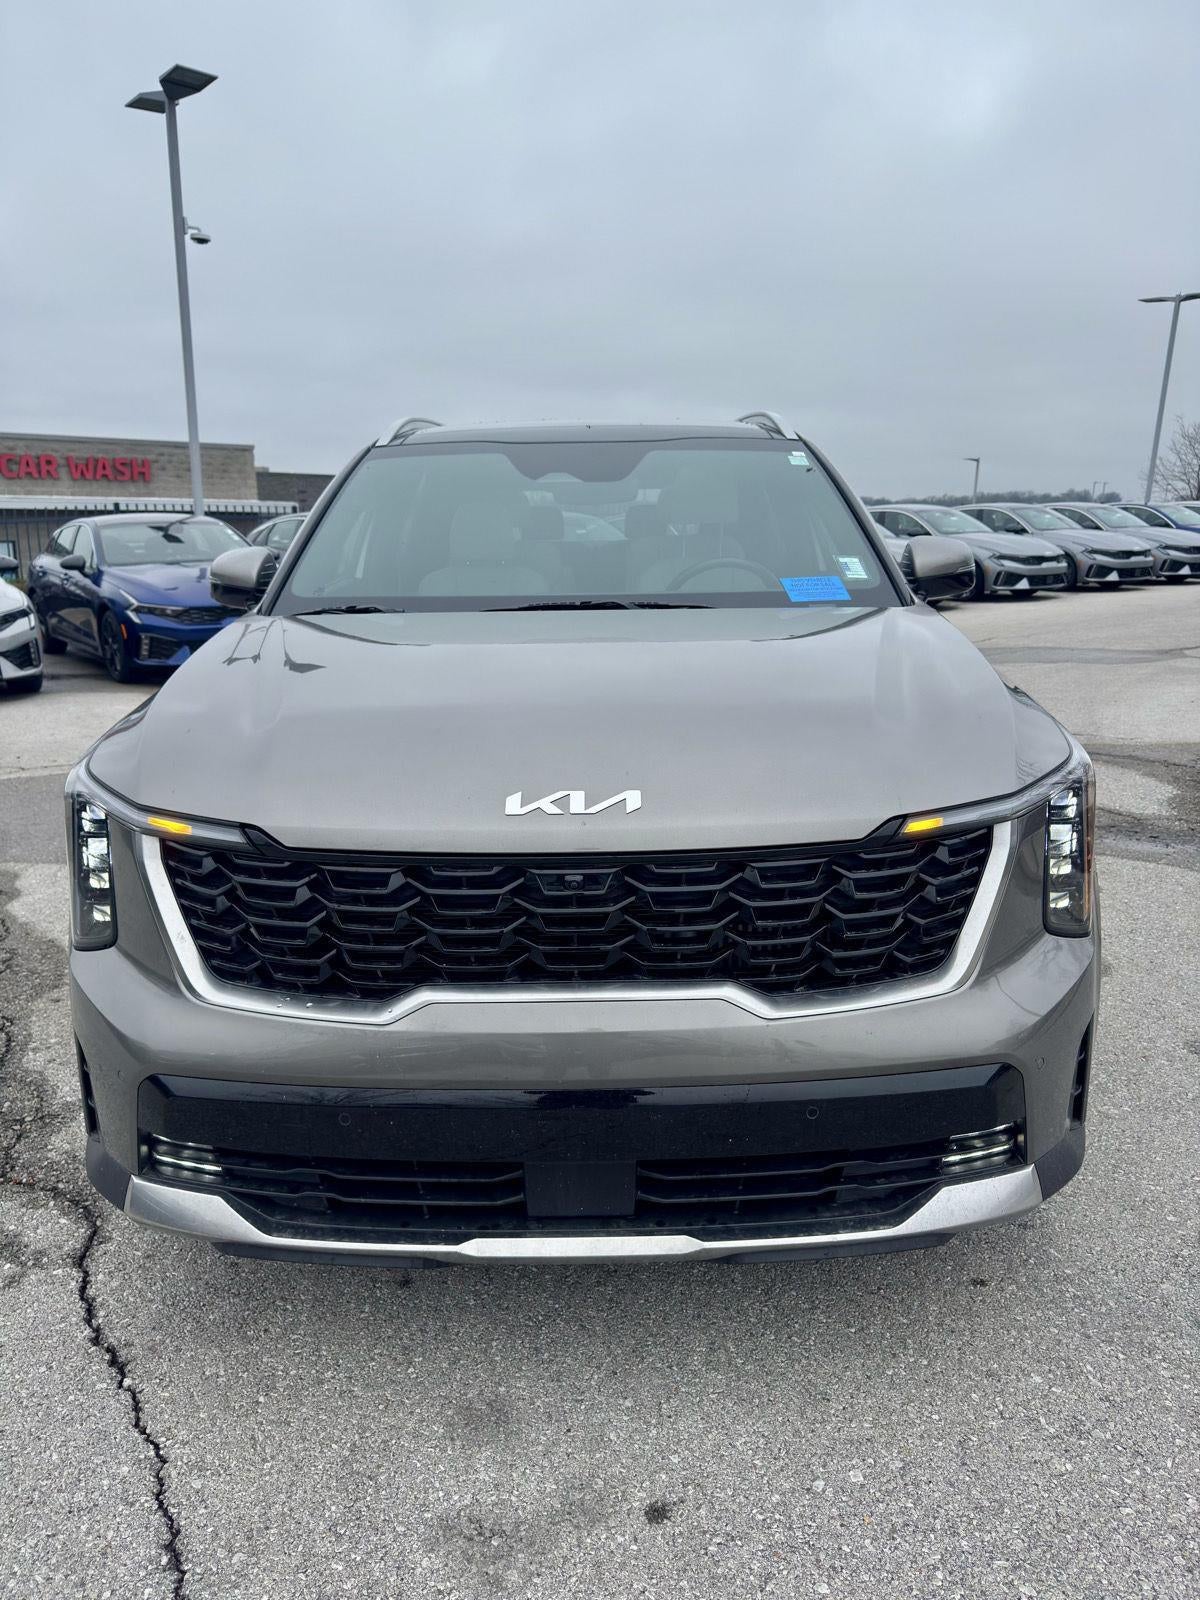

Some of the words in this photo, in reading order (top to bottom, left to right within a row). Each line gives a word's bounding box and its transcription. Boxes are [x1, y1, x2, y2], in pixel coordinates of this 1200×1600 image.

[0, 452, 59, 480] CAR
[67, 455, 152, 482] WASH
[505, 790, 642, 816] KIA
